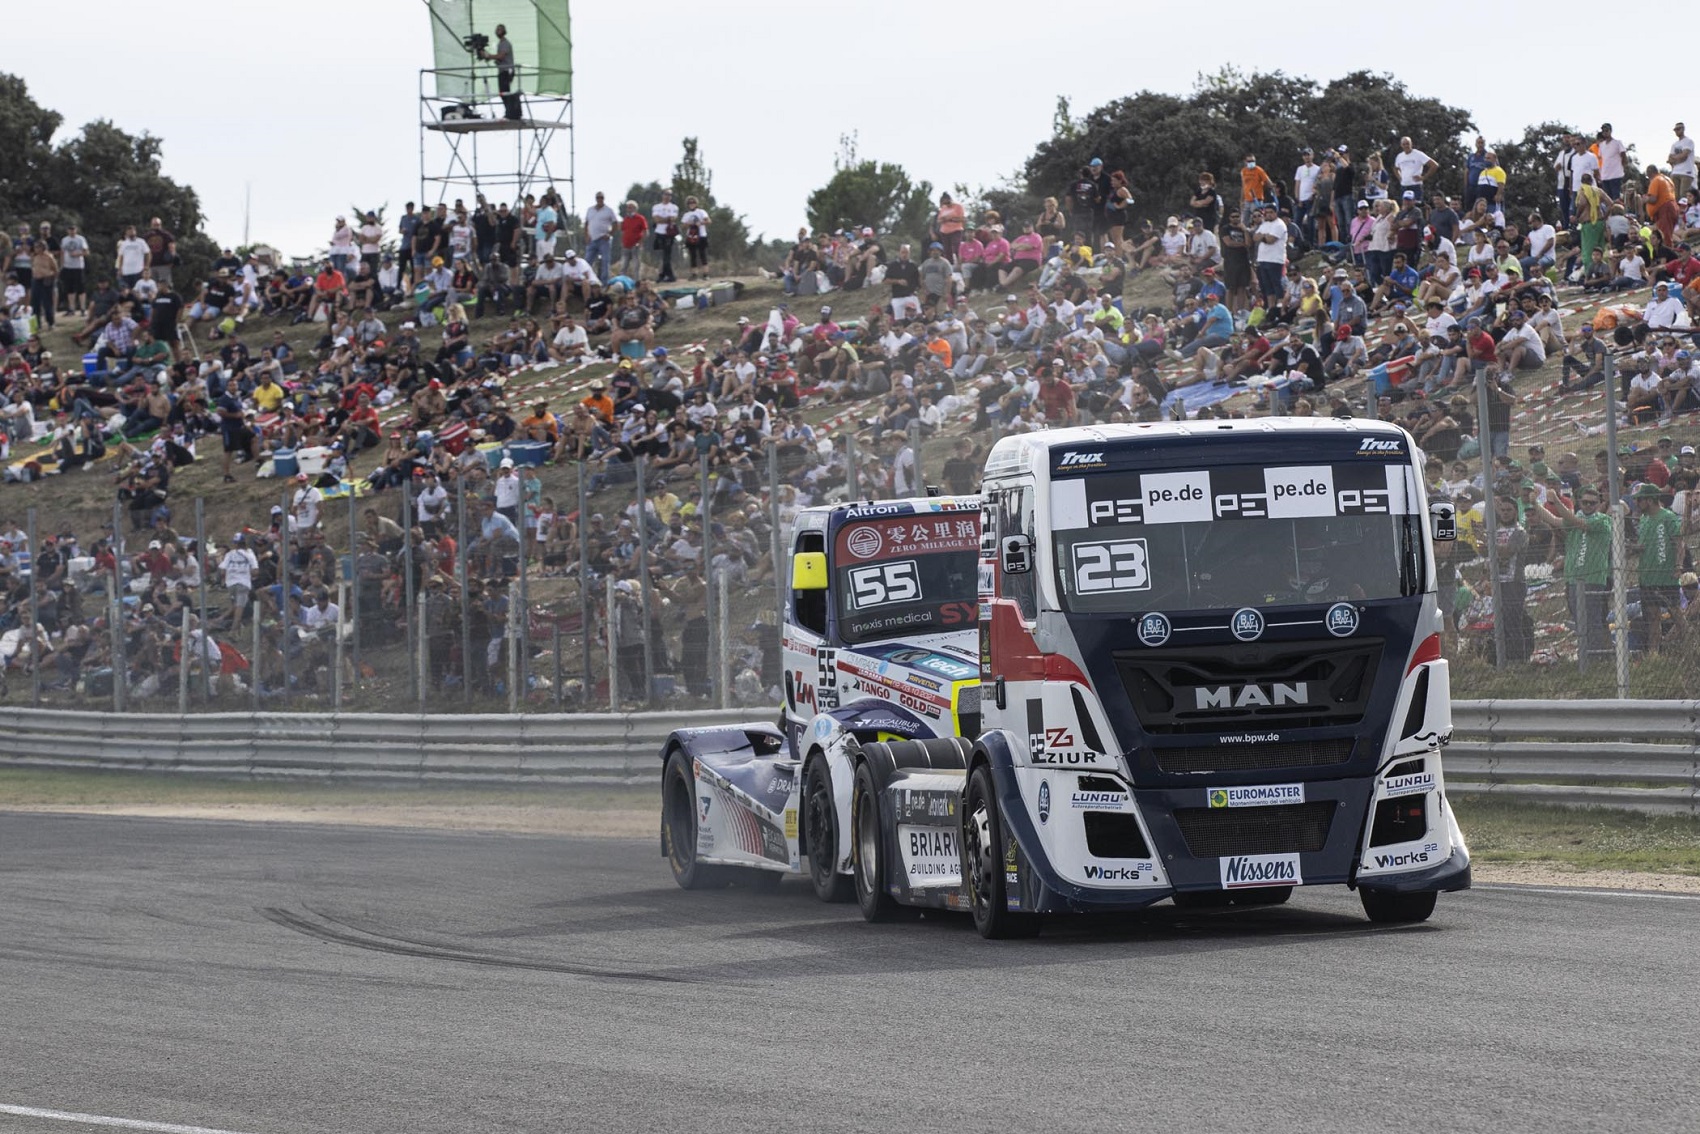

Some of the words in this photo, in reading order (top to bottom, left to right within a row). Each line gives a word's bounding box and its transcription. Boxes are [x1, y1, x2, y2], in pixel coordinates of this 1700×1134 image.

[1360, 437, 1400, 451] Trux
[1060, 452, 1104, 466] Trux
[1149, 484, 1203, 507] pe.de
[1273, 479, 1327, 501] pe.de
[845, 504, 899, 519] Altron
[890, 544, 917, 554] ZERO
[920, 539, 965, 551] MILEAGE
[1077, 543, 1147, 591] 23
[853, 563, 916, 606] 55
[852, 617, 883, 633] inoxis
[885, 611, 933, 627] medical
[818, 649, 836, 687] 55
[922, 657, 969, 677] tech
[860, 680, 890, 699] TANGO
[908, 675, 938, 690] RAVENOL
[899, 693, 927, 712] GOLD
[1195, 682, 1309, 709] MAN
[871, 718, 920, 730] EXCALIBUR
[1219, 733, 1280, 744] www.bpw.de
[1046, 751, 1096, 765] ZIUR
[1386, 773, 1432, 790] LUNAU
[1071, 793, 1120, 803] LUNAU
[1229, 786, 1300, 801] EUROMASTER
[1374, 851, 1429, 868] Works
[1424, 843, 1438, 852] 22
[909, 863, 946, 875] BUILDING
[1083, 865, 1140, 880] Works
[1137, 862, 1153, 871] 22
[1226, 857, 1295, 882] Nissens
